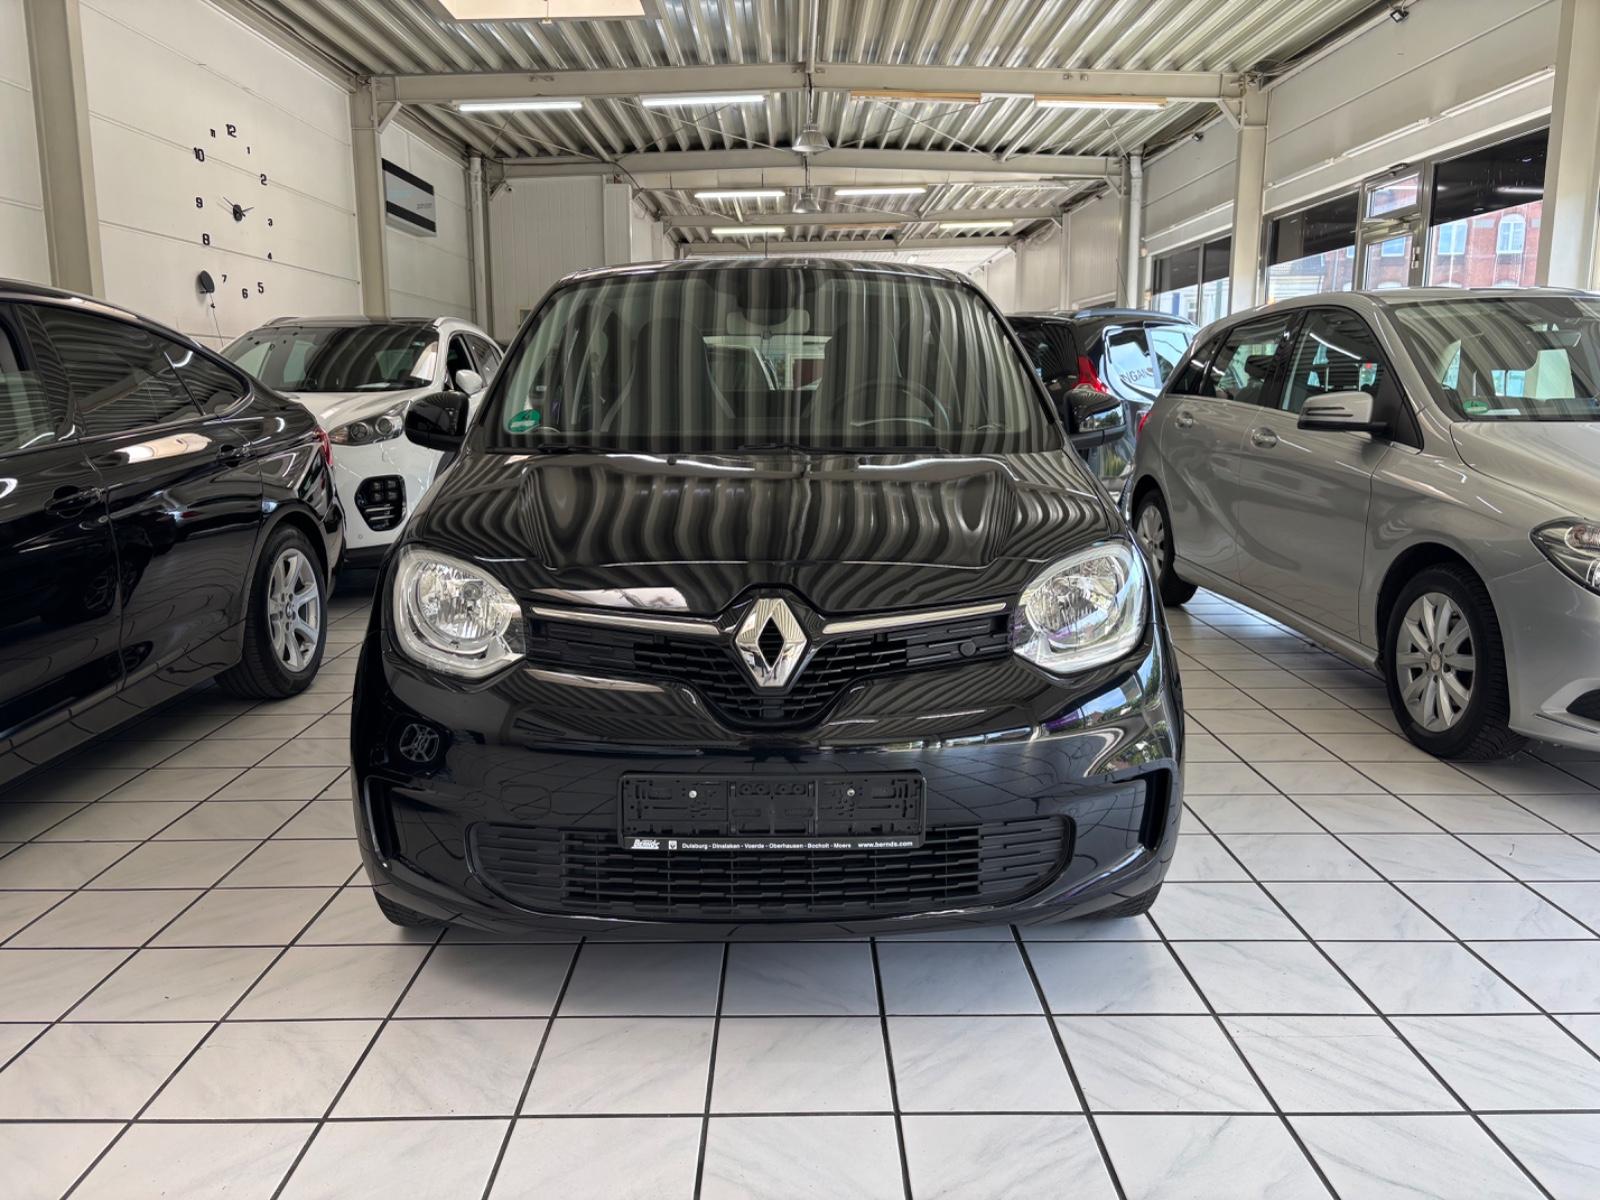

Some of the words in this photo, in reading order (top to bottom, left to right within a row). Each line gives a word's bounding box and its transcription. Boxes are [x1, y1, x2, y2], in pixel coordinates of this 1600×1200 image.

[209, 128, 216, 138] 11
[225, 123, 237, 138] 12
[193, 147, 205, 163] 10
[246, 146, 251, 155] 1
[260, 173, 268, 186] 2
[195, 197, 204, 208] 9
[267, 218, 273, 227] 3
[202, 233, 210, 246] 8
[267, 252, 273, 260] 4
[221, 274, 227, 283] 7
[241, 288, 249, 299] 6
[257, 282, 264, 294] 5
